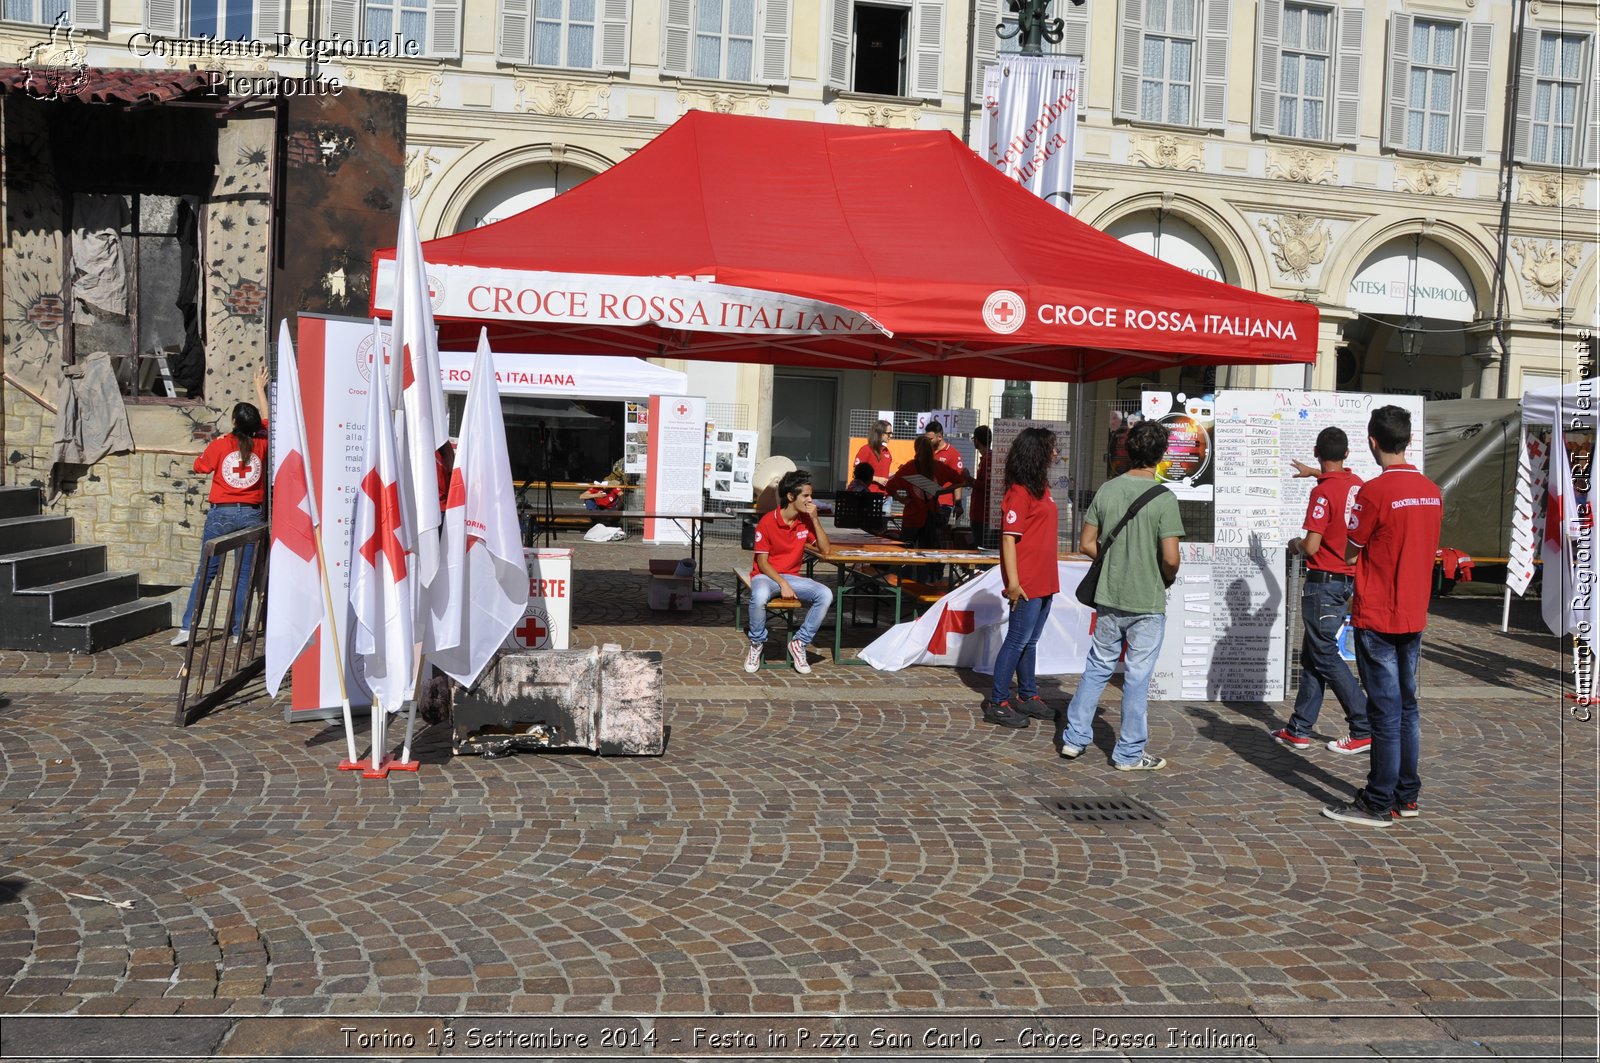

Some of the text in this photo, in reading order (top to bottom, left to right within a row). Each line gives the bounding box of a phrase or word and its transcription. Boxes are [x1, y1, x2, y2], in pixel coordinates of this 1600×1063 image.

[1409, 285, 1470, 303] SANPAOLO
[468, 285, 588, 318] CROCE
[600, 293, 710, 325] ROSSA
[720, 301, 880, 331] ITALIANA
[1038, 303, 1117, 328] CROCE
[1125, 309, 1197, 332] ROSSA
[1203, 314, 1297, 340] ITALIANA
[506, 372, 576, 386] ITALIANA
[345, 434, 362, 442] alla
[1216, 528, 1243, 544] AIDS
